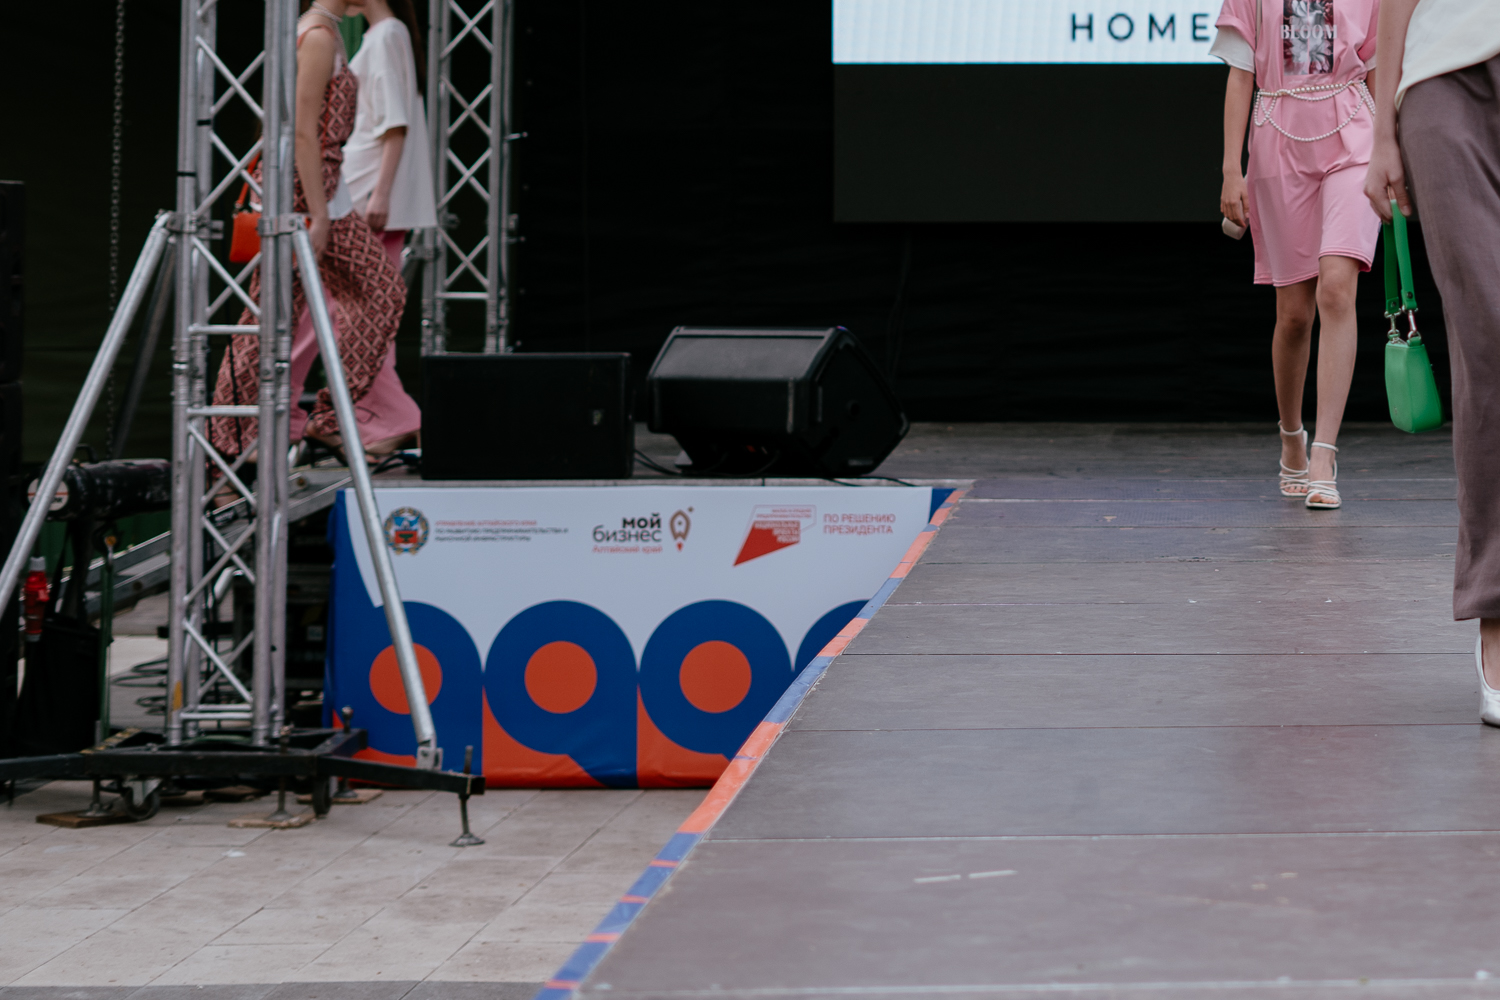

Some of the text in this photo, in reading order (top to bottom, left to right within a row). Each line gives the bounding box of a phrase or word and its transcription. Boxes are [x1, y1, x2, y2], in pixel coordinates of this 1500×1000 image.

[1071, 12, 1210, 42] HOME
[1280, 24, 1338, 39] BLOOM
[592, 525, 662, 542] бизнес
